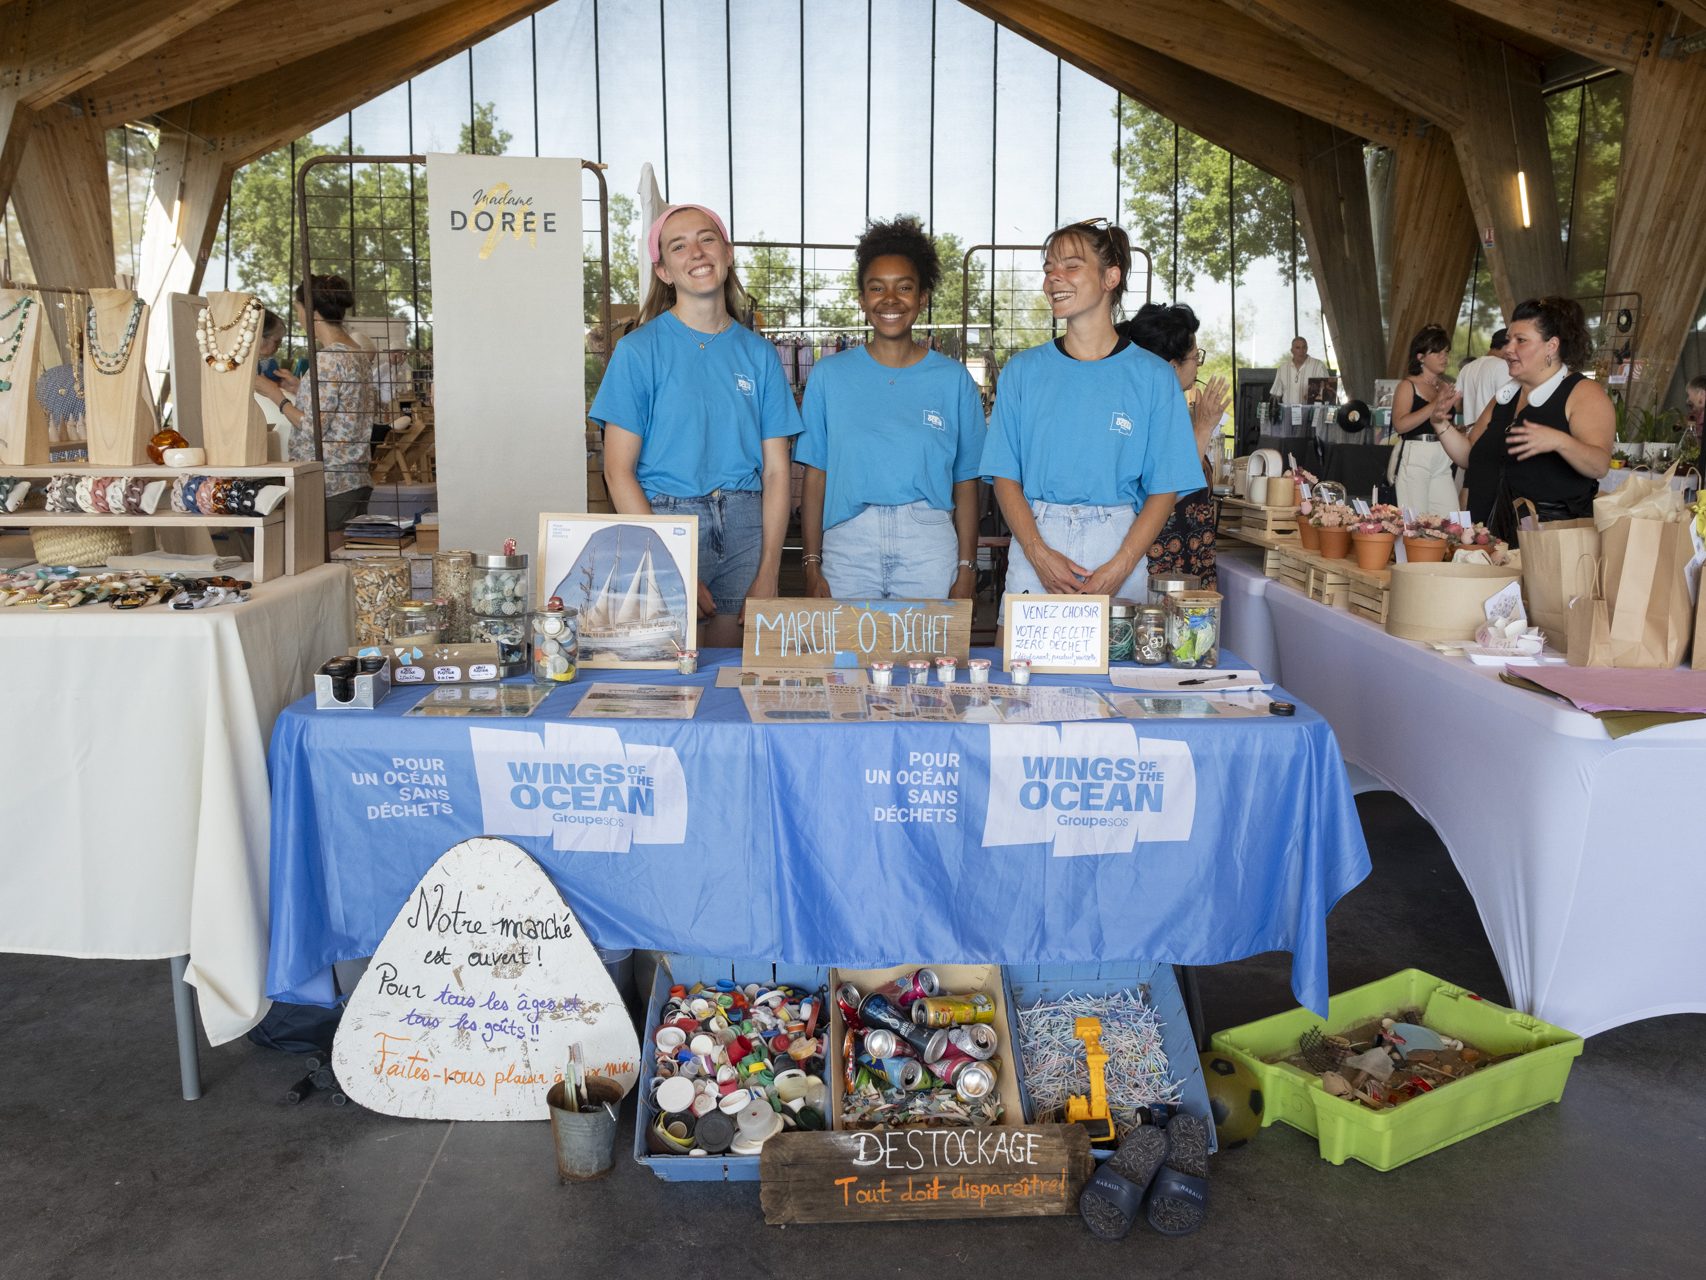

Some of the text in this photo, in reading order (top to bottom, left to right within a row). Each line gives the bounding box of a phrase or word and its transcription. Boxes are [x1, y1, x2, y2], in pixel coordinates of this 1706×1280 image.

[472, 188, 534, 206] Madame
[450, 210, 557, 233] DORÉE
[1023, 605, 1099, 619] VENEZ CHOISIR
[755, 605, 843, 656] MARCHÉ
[888, 606, 954, 654] DÉCHET
[1015, 625, 1097, 640] VOTRE RECETTE
[392, 757, 445, 771] POUR
[909, 751, 960, 768] POUR
[1022, 756, 1157, 782] WINGS OF
[351, 771, 448, 787] UN OCÉAN
[507, 762, 646, 785] WINGS OF
[628, 775, 654, 787] THE
[865, 768, 959, 786] UN OCÉAN
[1138, 772, 1164, 782] THE
[399, 787, 450, 801] SANS
[510, 784, 655, 817] OCEAN
[908, 789, 958, 805] SANS
[1019, 780, 1164, 813] OCEAN
[366, 802, 454, 820] DÉCHETS
[874, 805, 957, 823] DÉCHETS
[407, 884, 573, 940] Notre marché
[423, 946, 452, 966] est
[375, 962, 426, 999] Pour
[433, 983, 476, 1008] tous
[479, 991, 509, 1011] les
[516, 993, 557, 1024] âges
[399, 1008, 441, 1029] tous
[449, 1013, 478, 1032] les
[374, 1032, 486, 1087] Faites-vous
[494, 1064, 548, 1096] plaisir
[850, 1129, 1044, 1170] DESTOCKAGE
[834, 1176, 893, 1207] Tout
[901, 1175, 945, 1202] doit
